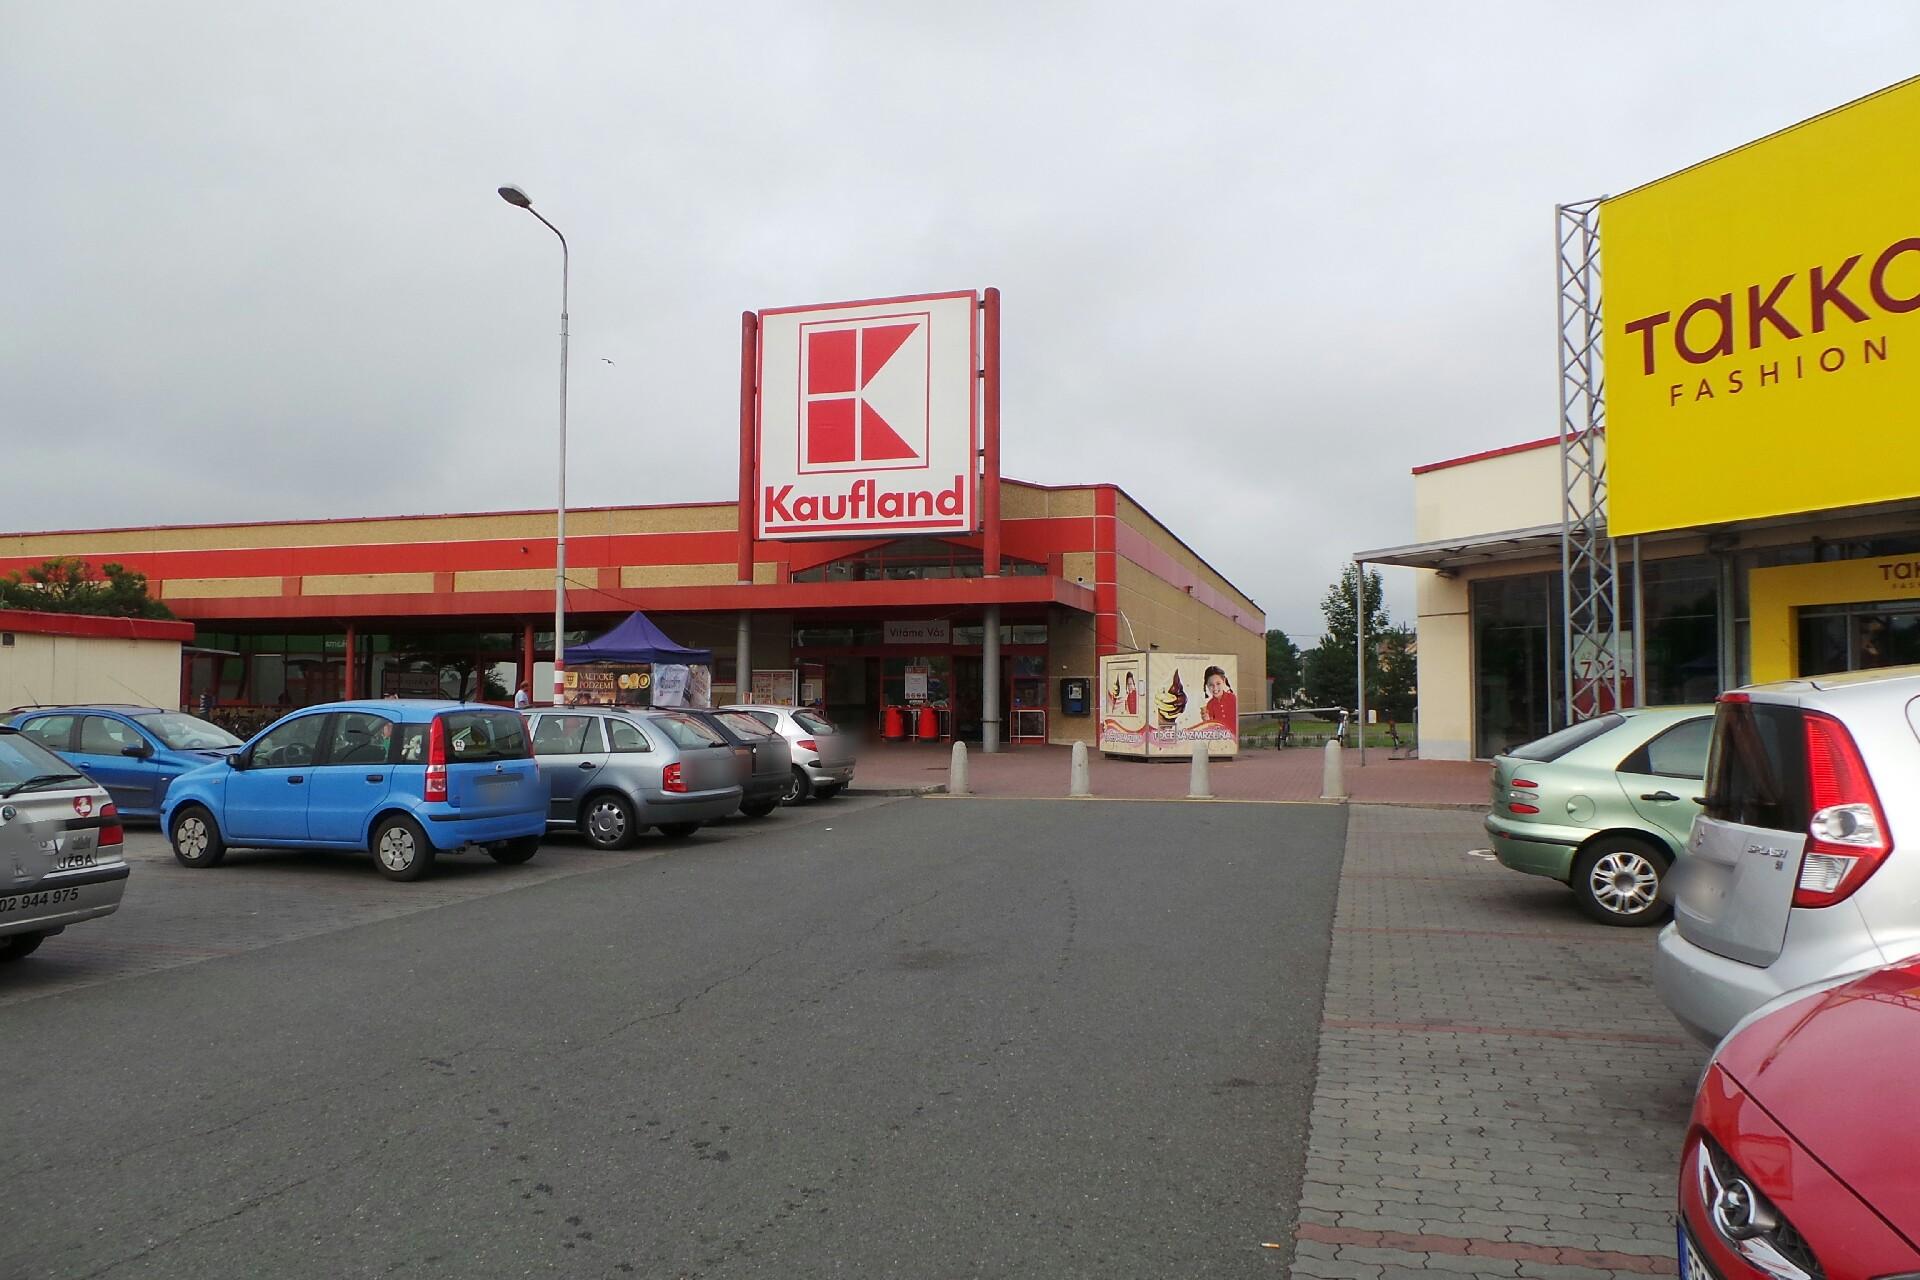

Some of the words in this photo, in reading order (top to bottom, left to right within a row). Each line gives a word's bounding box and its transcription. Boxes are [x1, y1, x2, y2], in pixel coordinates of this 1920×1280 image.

[1671, 335, 1887, 407] FASHION
[764, 474, 964, 523] Kaufland
[57, 853, 95, 869] UŽBA
[21, 891, 49, 910] 944
[52, 887, 79, 904] 975
